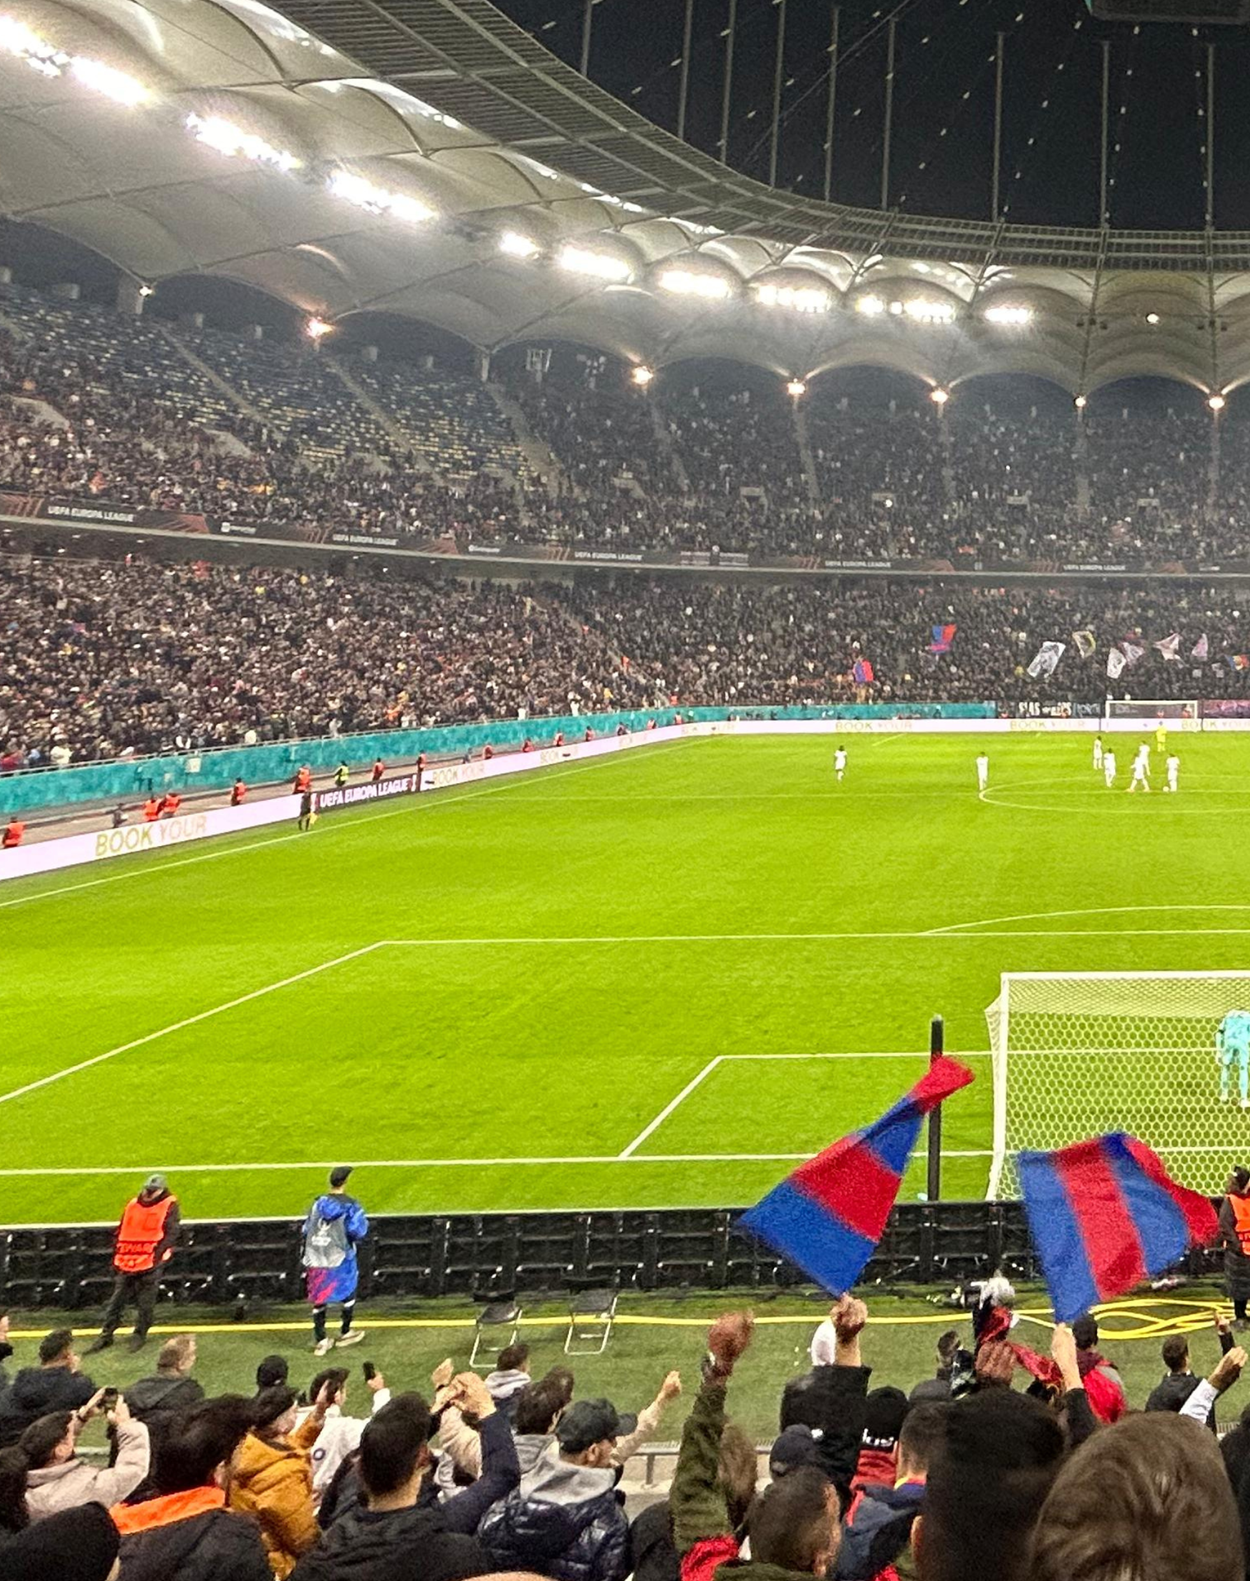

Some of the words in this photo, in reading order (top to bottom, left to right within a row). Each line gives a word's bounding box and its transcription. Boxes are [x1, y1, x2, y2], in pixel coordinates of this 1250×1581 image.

[47, 505, 70, 516] UEFA
[71, 507, 103, 519] EUROPA
[103, 511, 134, 522] LEAGUE
[835, 721, 873, 731] BOOK
[1010, 720, 1046, 730] BOOK
[320, 790, 344, 807] UEFA
[344, 783, 378, 803] EUROPA
[378, 778, 409, 796] LEAGUE
[95, 824, 153, 857] BOOK
[157, 815, 207, 841] YOUR
